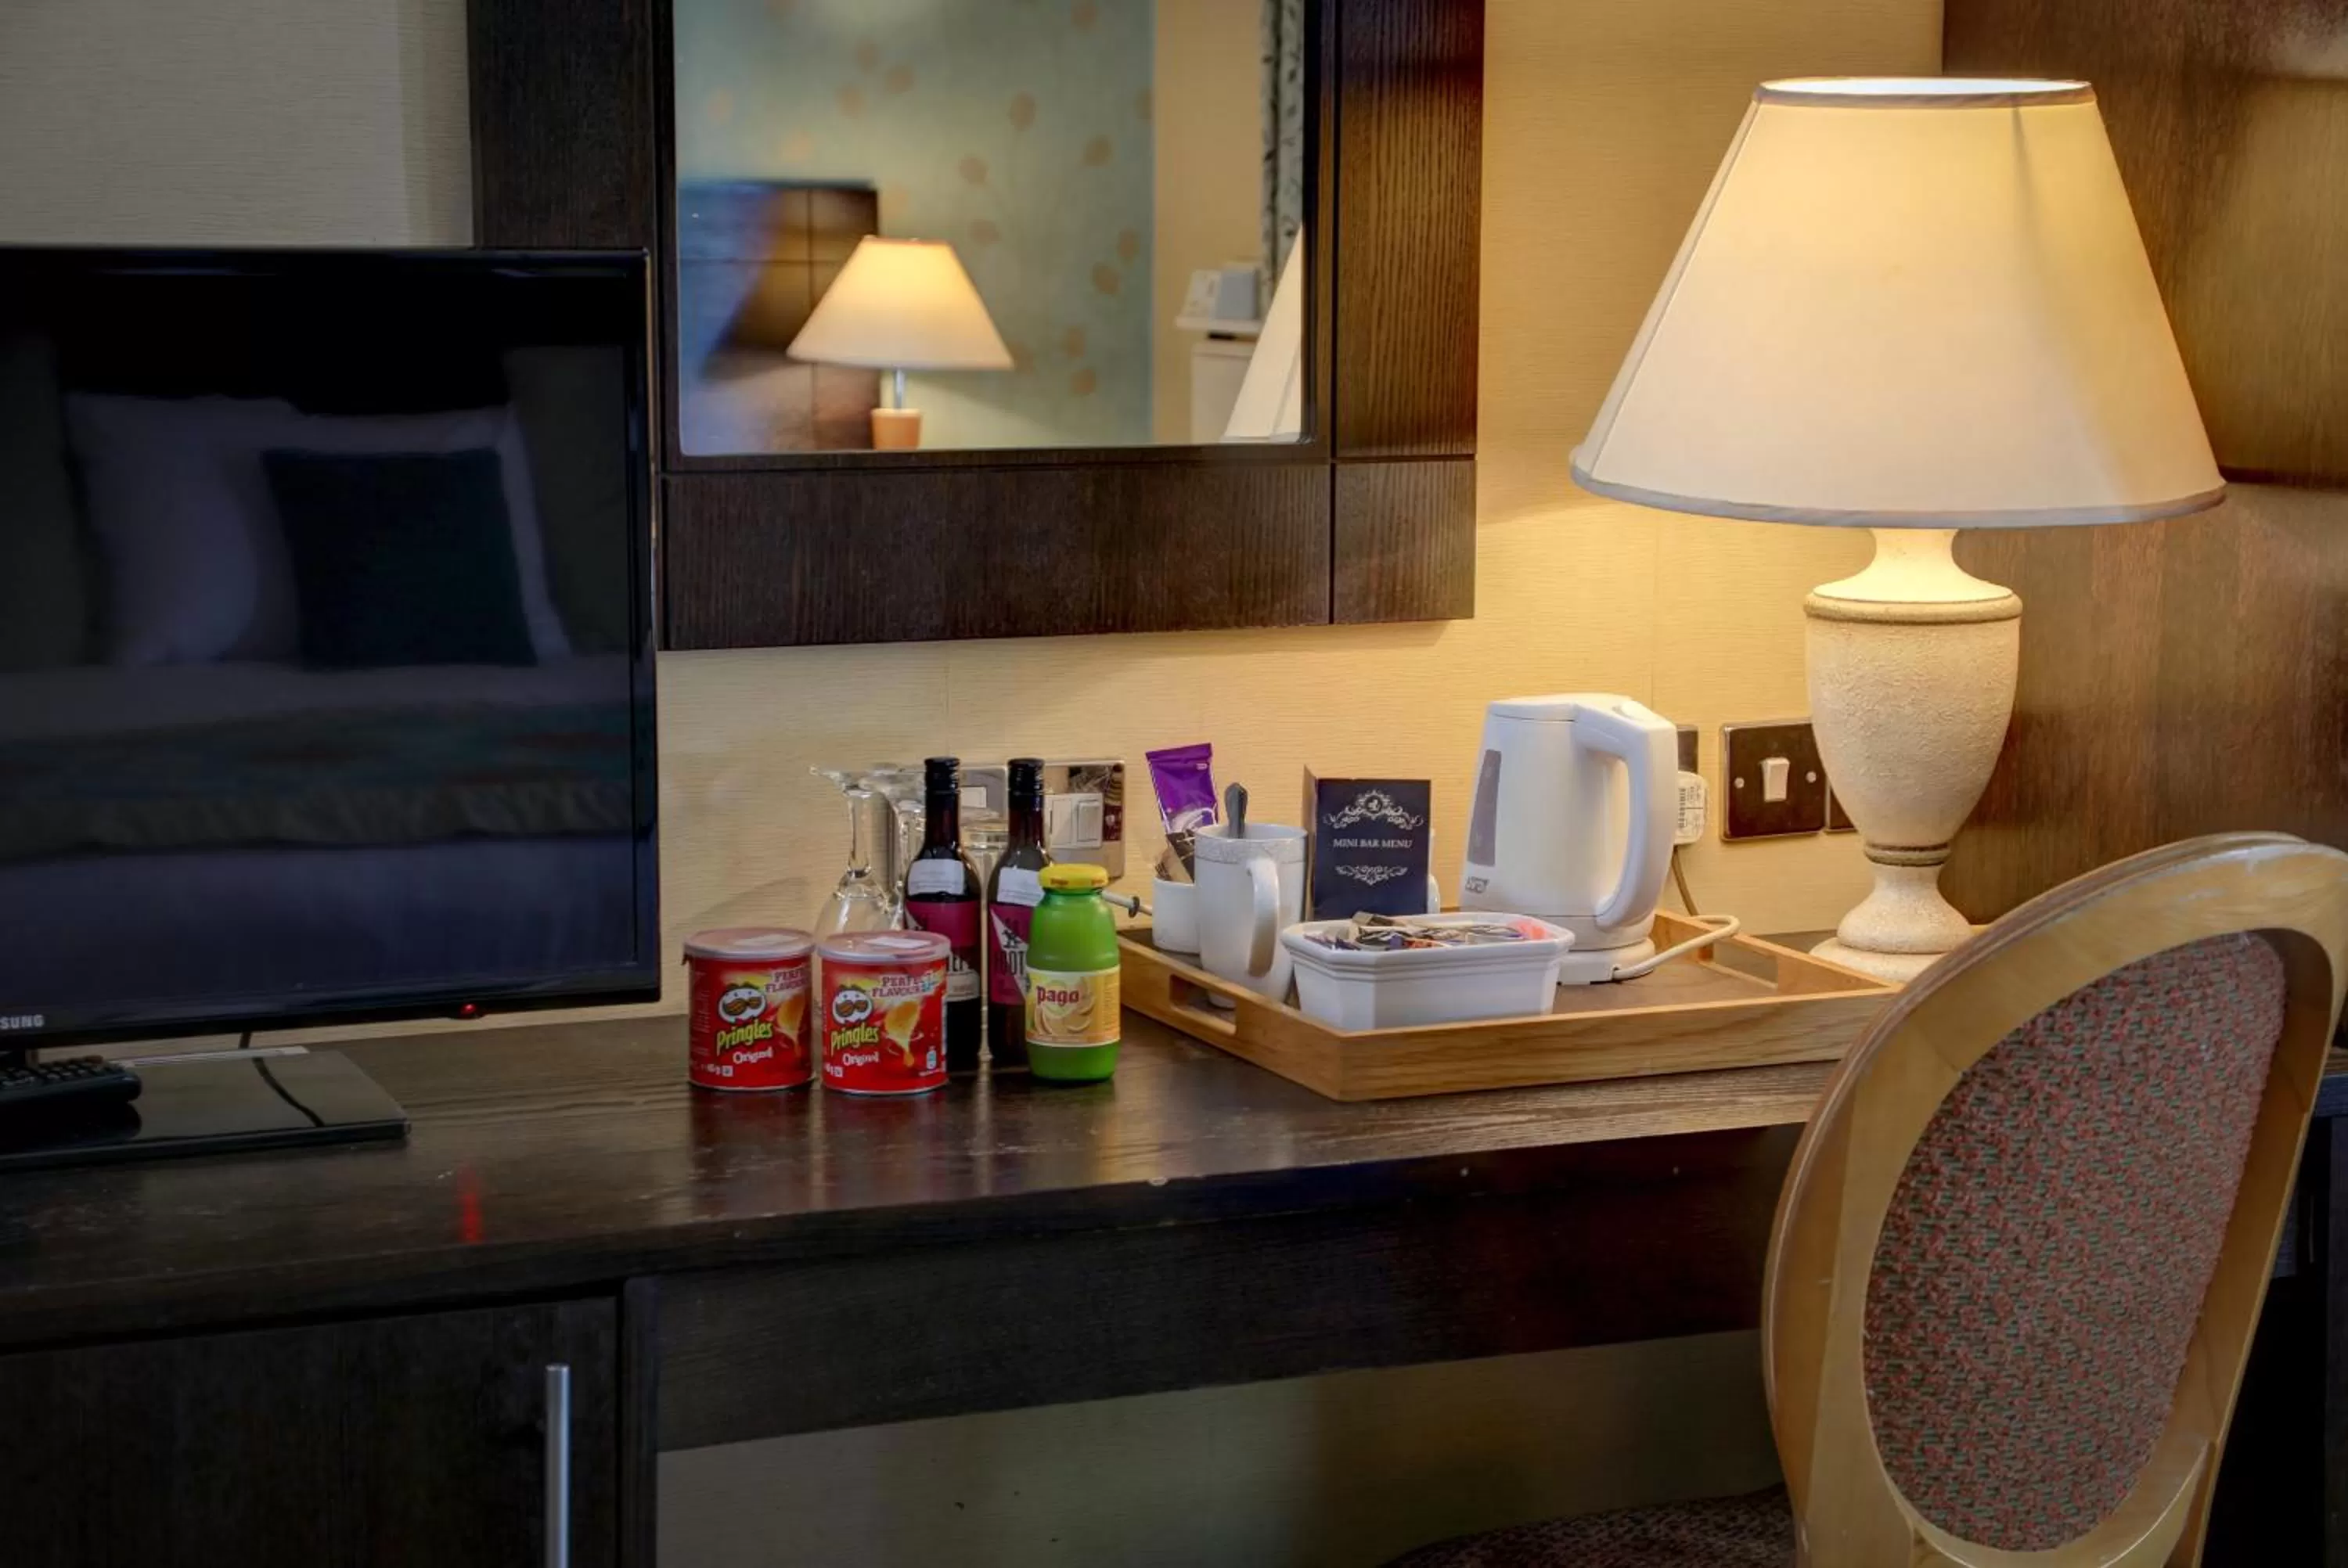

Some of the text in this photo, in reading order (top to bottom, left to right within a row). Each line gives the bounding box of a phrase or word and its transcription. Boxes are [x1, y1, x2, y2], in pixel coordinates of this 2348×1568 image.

[1332, 839, 1413, 849] MINI BAR MENU
[1036, 985, 1080, 1005] pago
[716, 1019, 773, 1056] Pringles
[830, 1022, 879, 1056] Pringles
[733, 1046, 774, 1063] Original
[842, 1052, 879, 1066] Original
